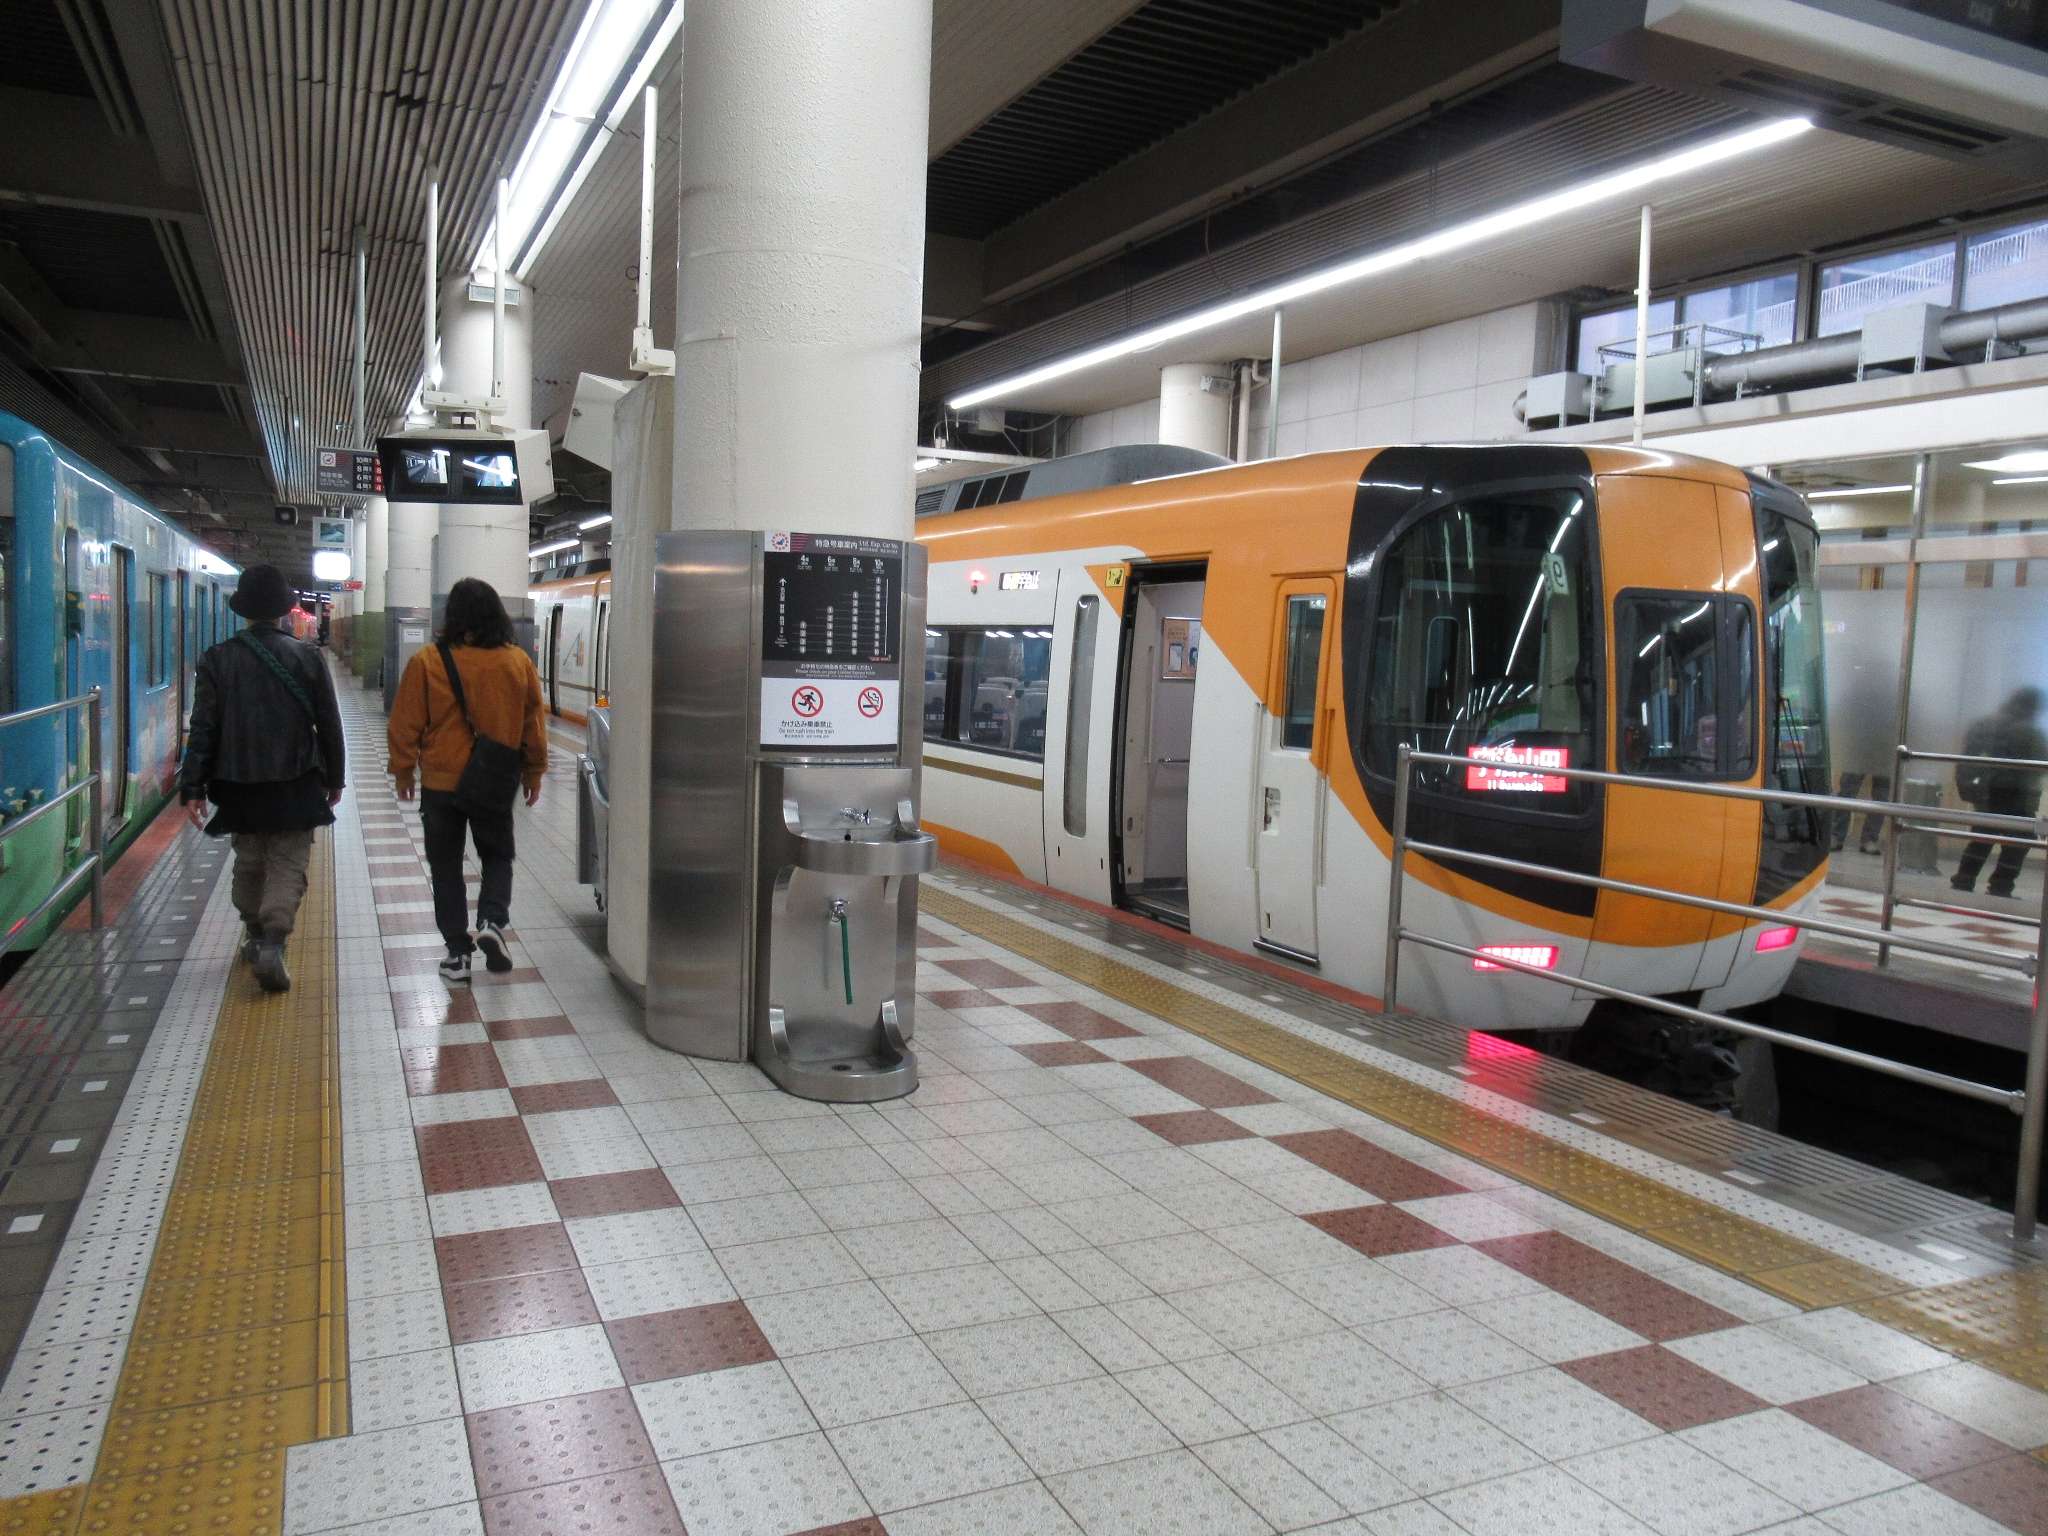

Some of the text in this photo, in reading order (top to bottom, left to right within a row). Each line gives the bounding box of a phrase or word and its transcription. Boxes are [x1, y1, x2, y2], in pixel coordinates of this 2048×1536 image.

[781, 720, 833, 728] かけ込み乗車禁止
